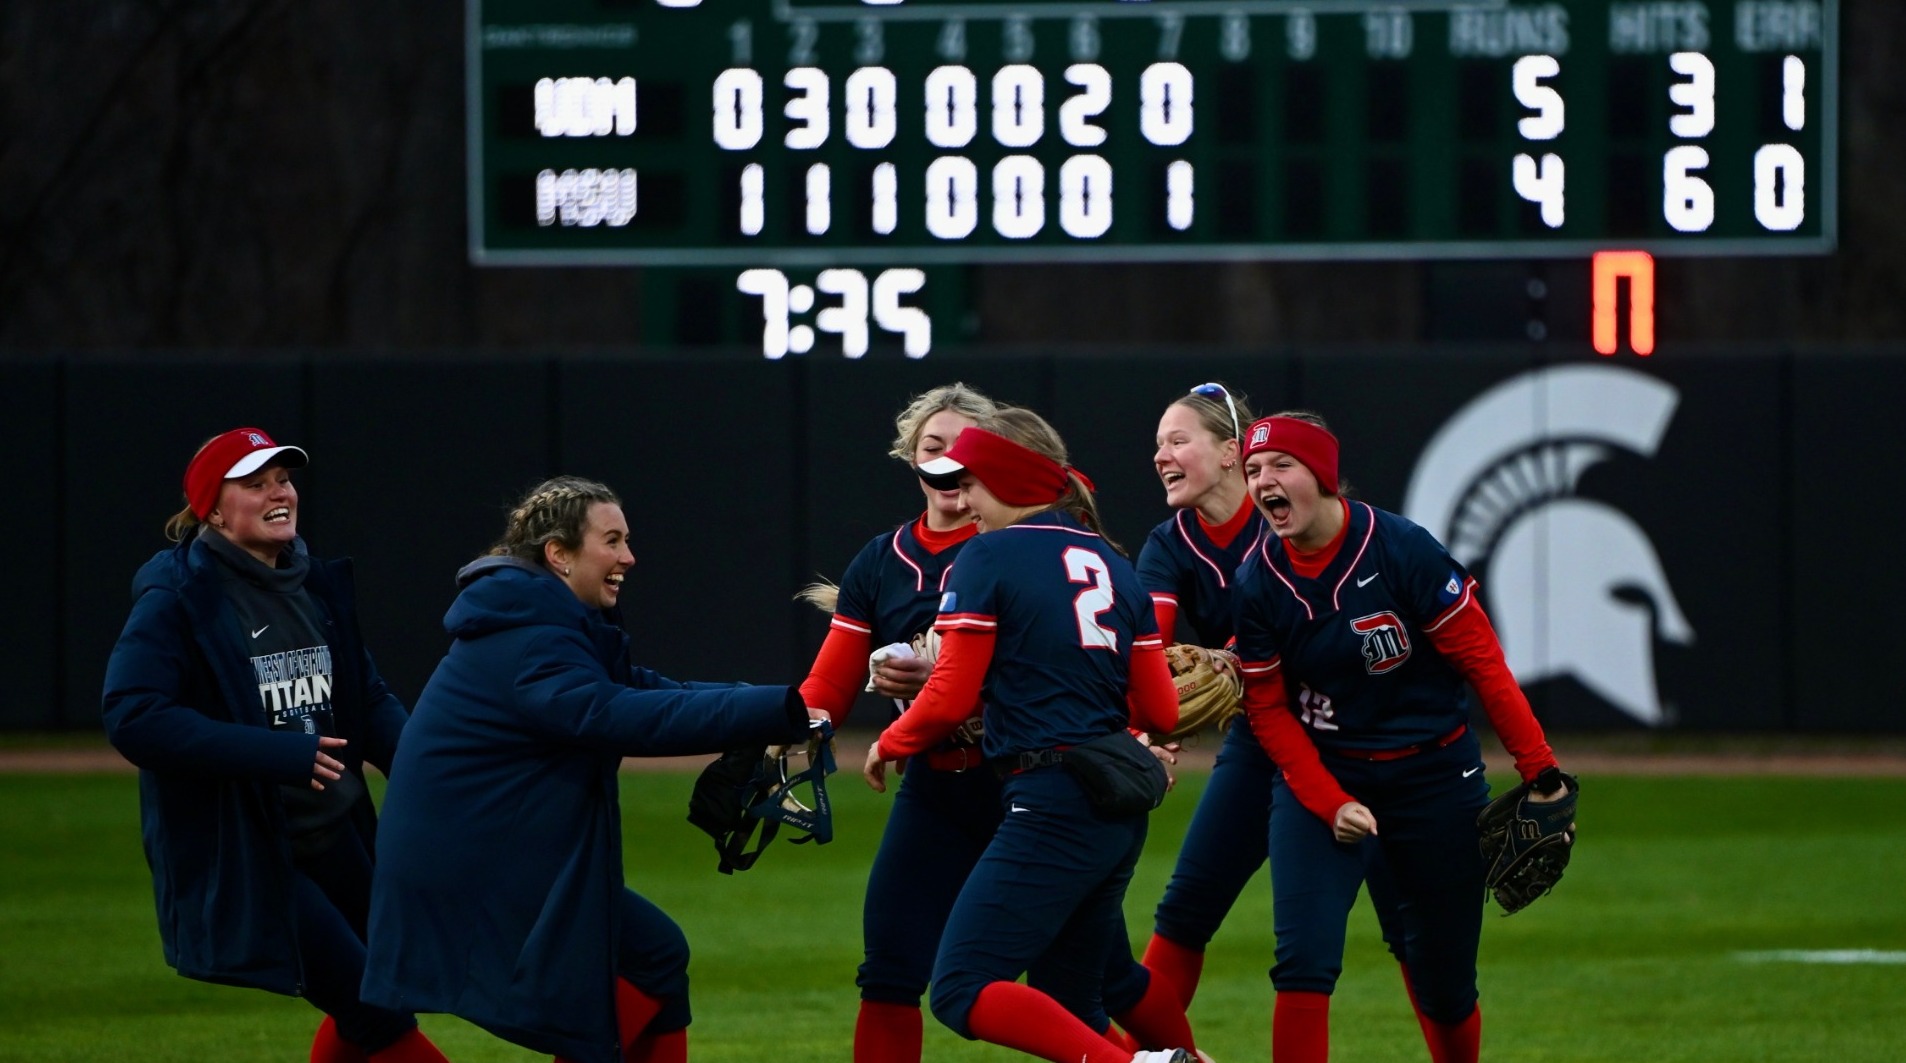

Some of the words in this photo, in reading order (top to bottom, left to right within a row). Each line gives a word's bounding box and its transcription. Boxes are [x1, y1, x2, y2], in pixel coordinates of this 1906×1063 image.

[727, 19, 754, 64] 1
[788, 15, 818, 65] 2
[854, 15, 886, 64] 3
[936, 14, 968, 60] 4
[1156, 10, 1185, 60] 7
[1363, 6, 1414, 58] 10
[1449, 5, 1569, 56] RUNS
[1609, 2, 1710, 53] HITS
[713, 68, 763, 150] 0
[784, 67, 830, 149] 3
[846, 67, 897, 149] 0
[925, 65, 977, 147] 0
[992, 65, 1044, 147] 0
[1060, 64, 1112, 146] 2
[1141, 62, 1193, 145] 0
[1513, 55, 1565, 140] 5
[1669, 52, 1715, 137] 3
[1784, 55, 1805, 130] 1
[536, 168, 637, 227] MSU
[740, 163, 764, 235] 1
[807, 163, 830, 235] 1
[873, 162, 897, 234] 1
[926, 156, 977, 238] 0
[993, 155, 1044, 238] 0
[1060, 154, 1112, 238] 0
[1168, 160, 1194, 230] 1
[1513, 153, 1564, 227] 4
[1664, 146, 1714, 232] 6
[1754, 144, 1804, 230] 0
[1061, 545, 1119, 653] 2
[1299, 682, 1339, 731] 12
